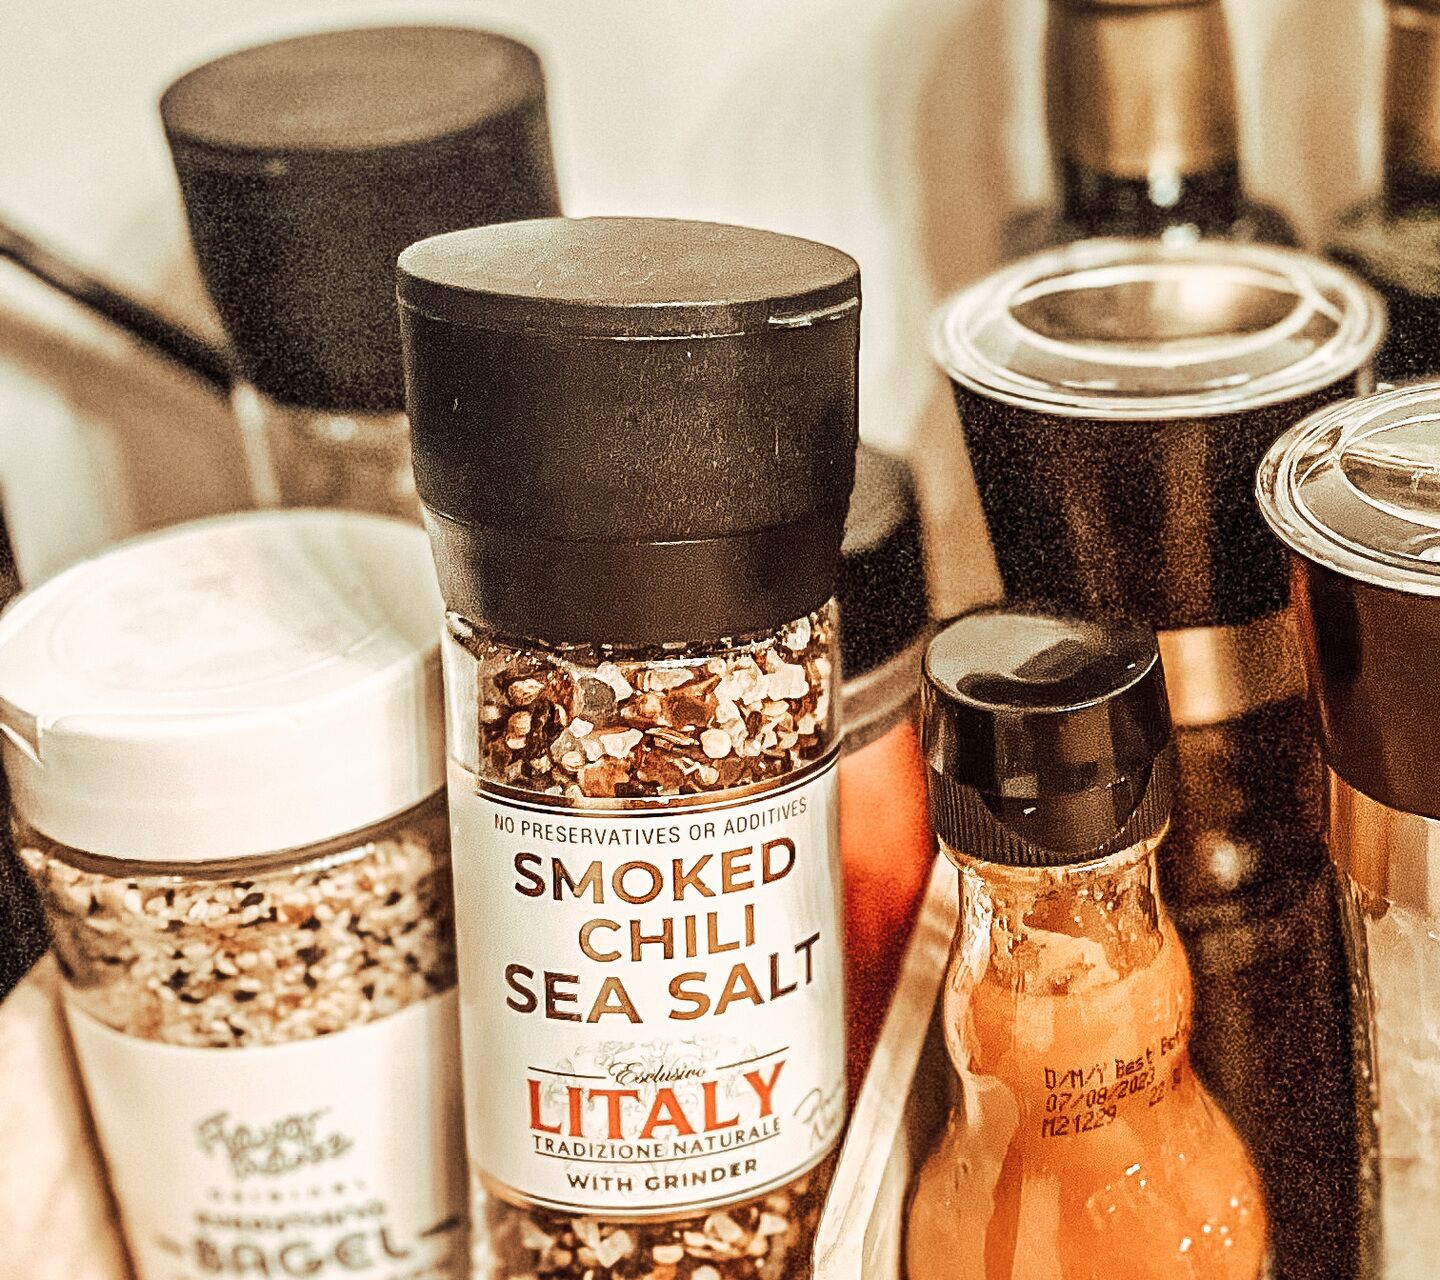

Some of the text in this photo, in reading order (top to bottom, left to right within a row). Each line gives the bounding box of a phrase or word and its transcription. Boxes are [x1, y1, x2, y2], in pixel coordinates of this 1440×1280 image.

[494, 796, 808, 845] NO PRESERVATIVES OR ADDITIVES
[513, 836, 796, 905] SMOKED
[578, 903, 756, 963] CHILI
[504, 931, 820, 1025] SEA SALT
[527, 1059, 787, 1141] LITALY
[608, 1062, 708, 1086] Esclusivo
[532, 1116, 782, 1160] TRADIZIONE NATURALE
[566, 1157, 758, 1193] WITH GRINDER
